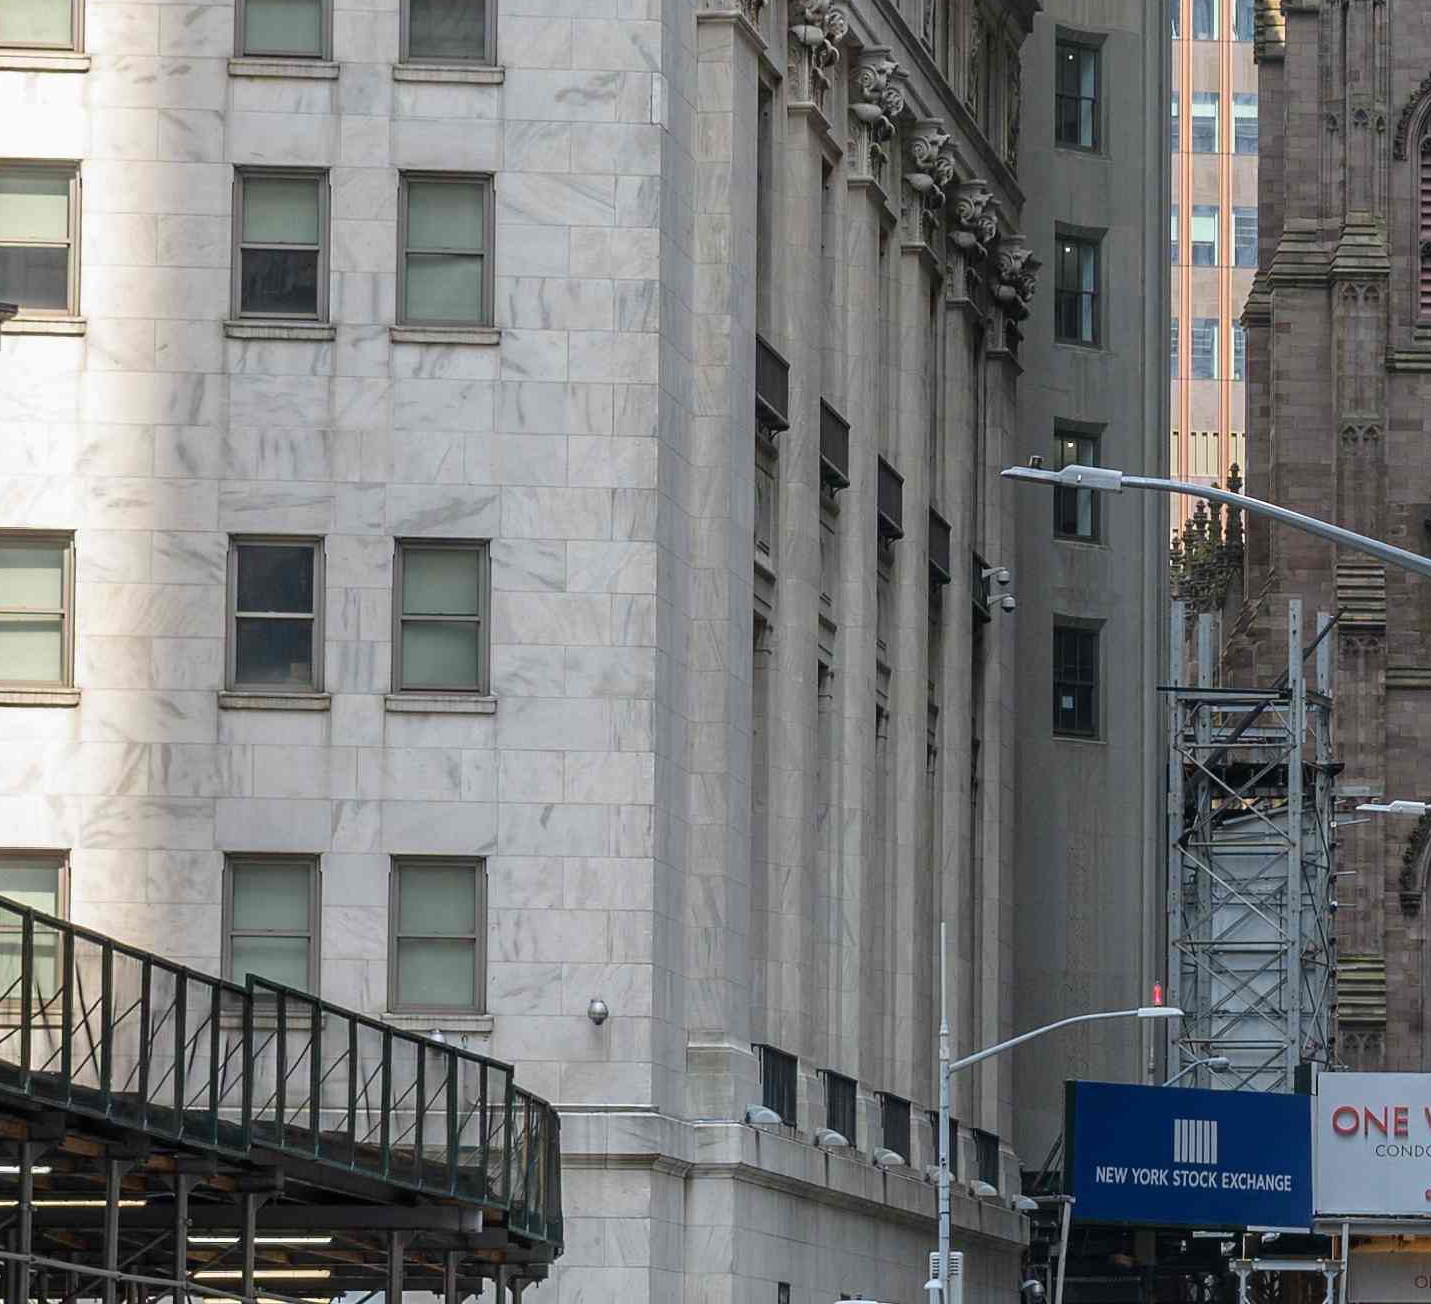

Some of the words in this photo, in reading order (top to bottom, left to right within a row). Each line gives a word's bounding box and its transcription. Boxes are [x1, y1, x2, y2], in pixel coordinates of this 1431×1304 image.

[1332, 1107, 1409, 1138] ONE
[1096, 1166, 1128, 1184] NEW
[1132, 1168, 1169, 1186] YORK
[1173, 1171, 1218, 1188] STOCK
[1222, 1173, 1292, 1192] EXCHANGE
